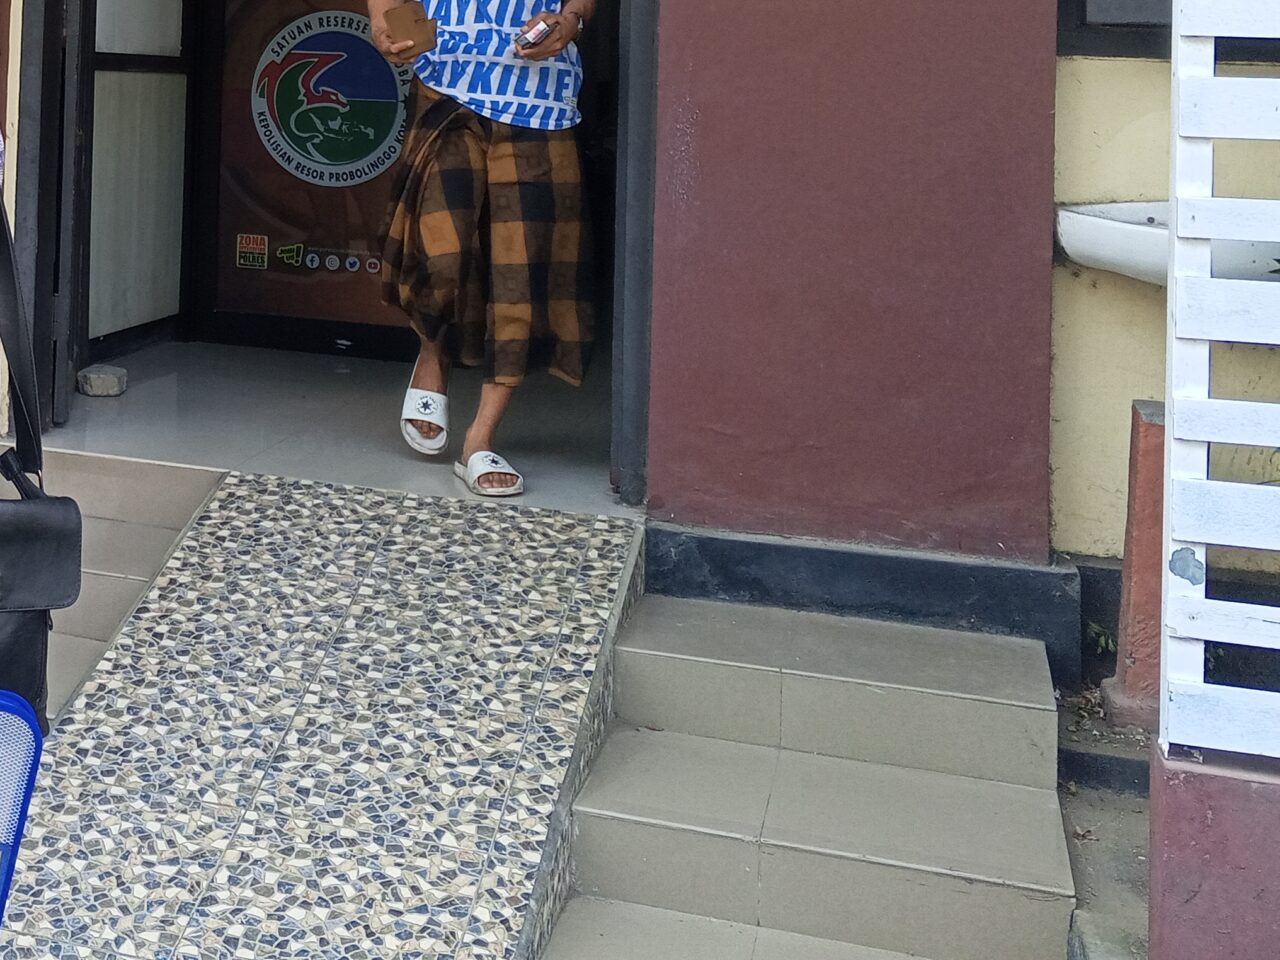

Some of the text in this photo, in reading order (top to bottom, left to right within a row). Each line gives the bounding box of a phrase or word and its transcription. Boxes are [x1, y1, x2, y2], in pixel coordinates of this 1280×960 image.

[271, 15, 370, 58] SATUAN RESERSE
[256, 110, 294, 166] KEPOLISIAN
[294, 161, 326, 182] RESOR
[328, 145, 397, 183] PROBOLINGGO
[239, 235, 266, 247] ZONA
